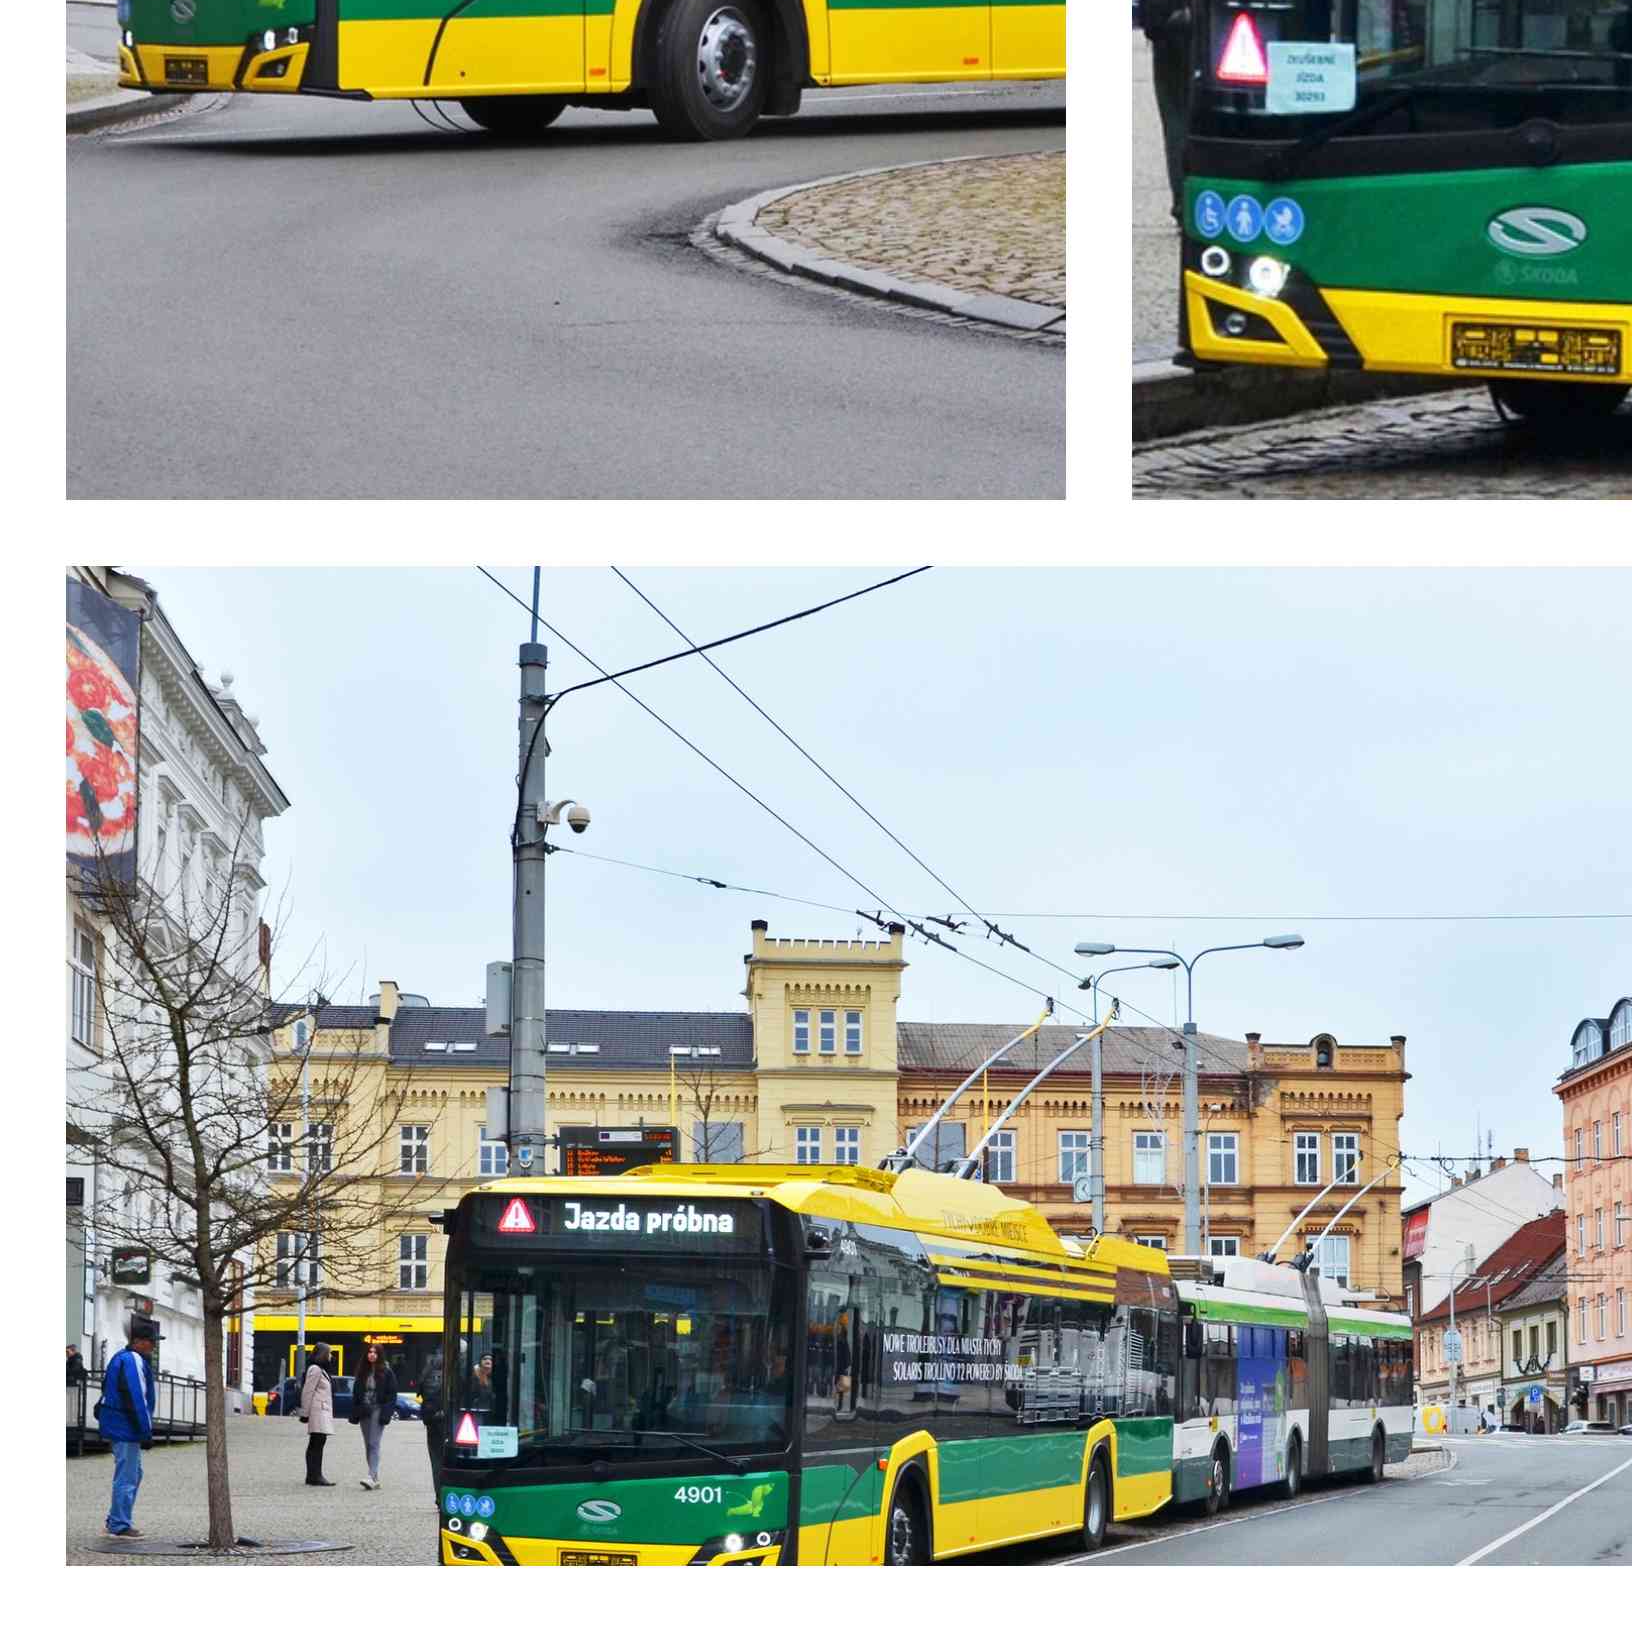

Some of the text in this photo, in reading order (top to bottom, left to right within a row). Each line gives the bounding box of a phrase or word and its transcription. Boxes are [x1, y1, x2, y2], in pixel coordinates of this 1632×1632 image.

[1520, 264, 1579, 284] ŠKODA
[564, 1202, 734, 1233] Jazda próbna
[883, 1334, 905, 1353] NOWE
[906, 1334, 947, 1355] TROLEJBUSY
[948, 1336, 961, 1355] DLA
[961, 1337, 982, 1356] MIASTA
[893, 1361, 922, 1381] SOLARIS
[924, 1362, 956, 1381] TROLLINO
[966, 1363, 995, 1381] POWERED
[674, 1486, 722, 1504] 4901
